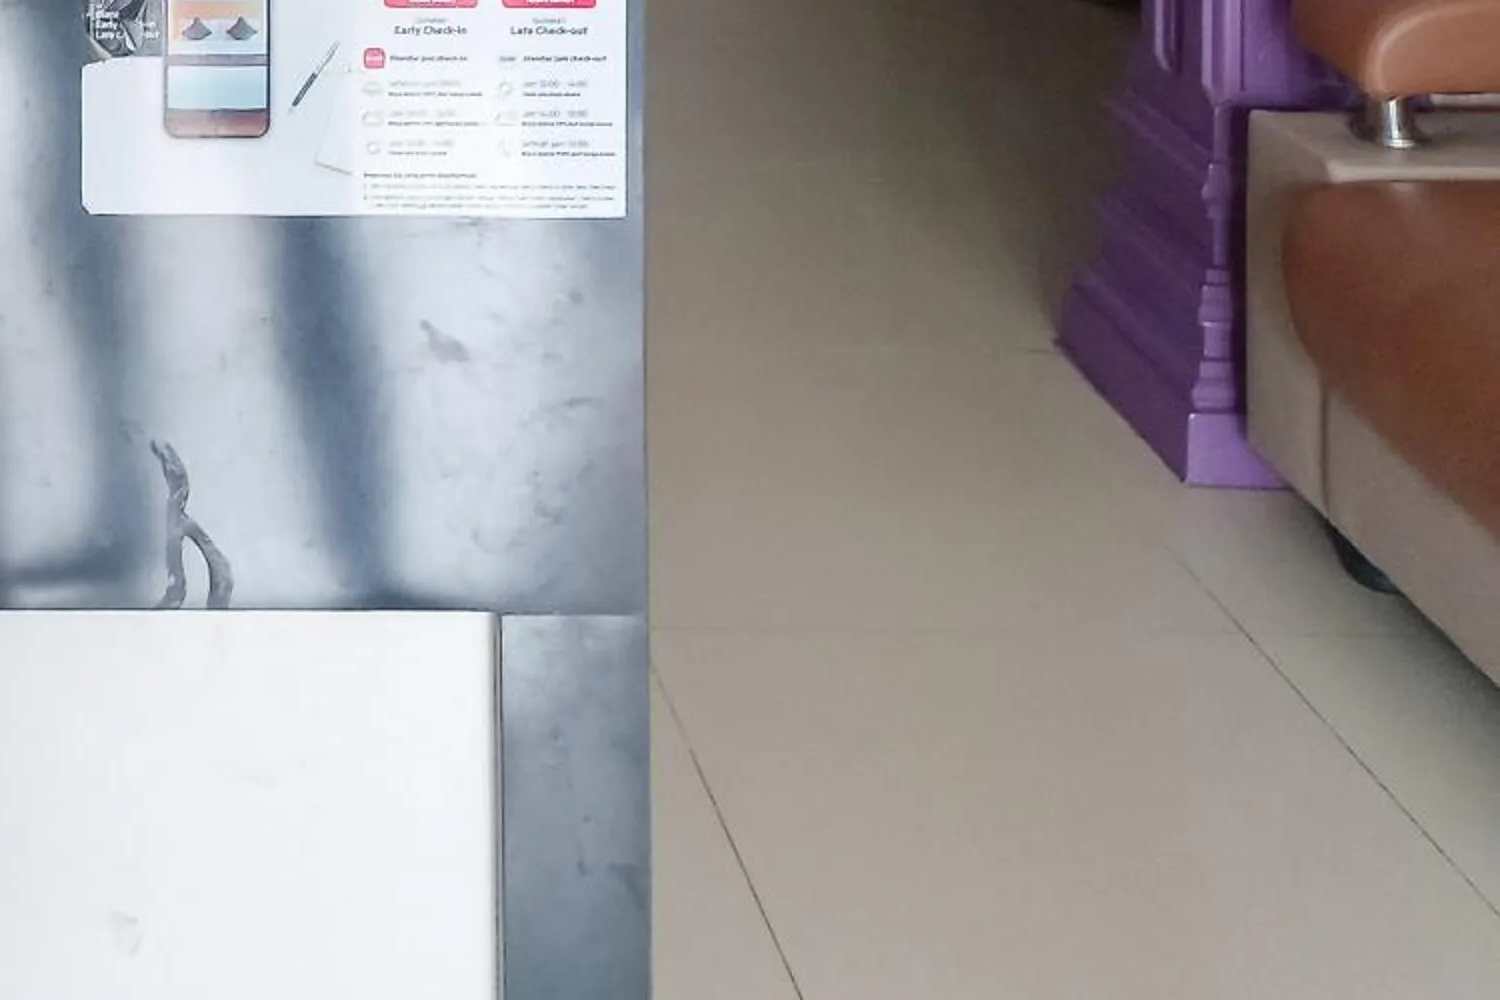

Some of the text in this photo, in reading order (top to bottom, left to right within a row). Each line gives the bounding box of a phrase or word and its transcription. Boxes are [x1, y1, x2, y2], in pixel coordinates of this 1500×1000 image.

[394, 25, 468, 38] Early Check-in
[510, 26, 587, 36] Late Check-out
